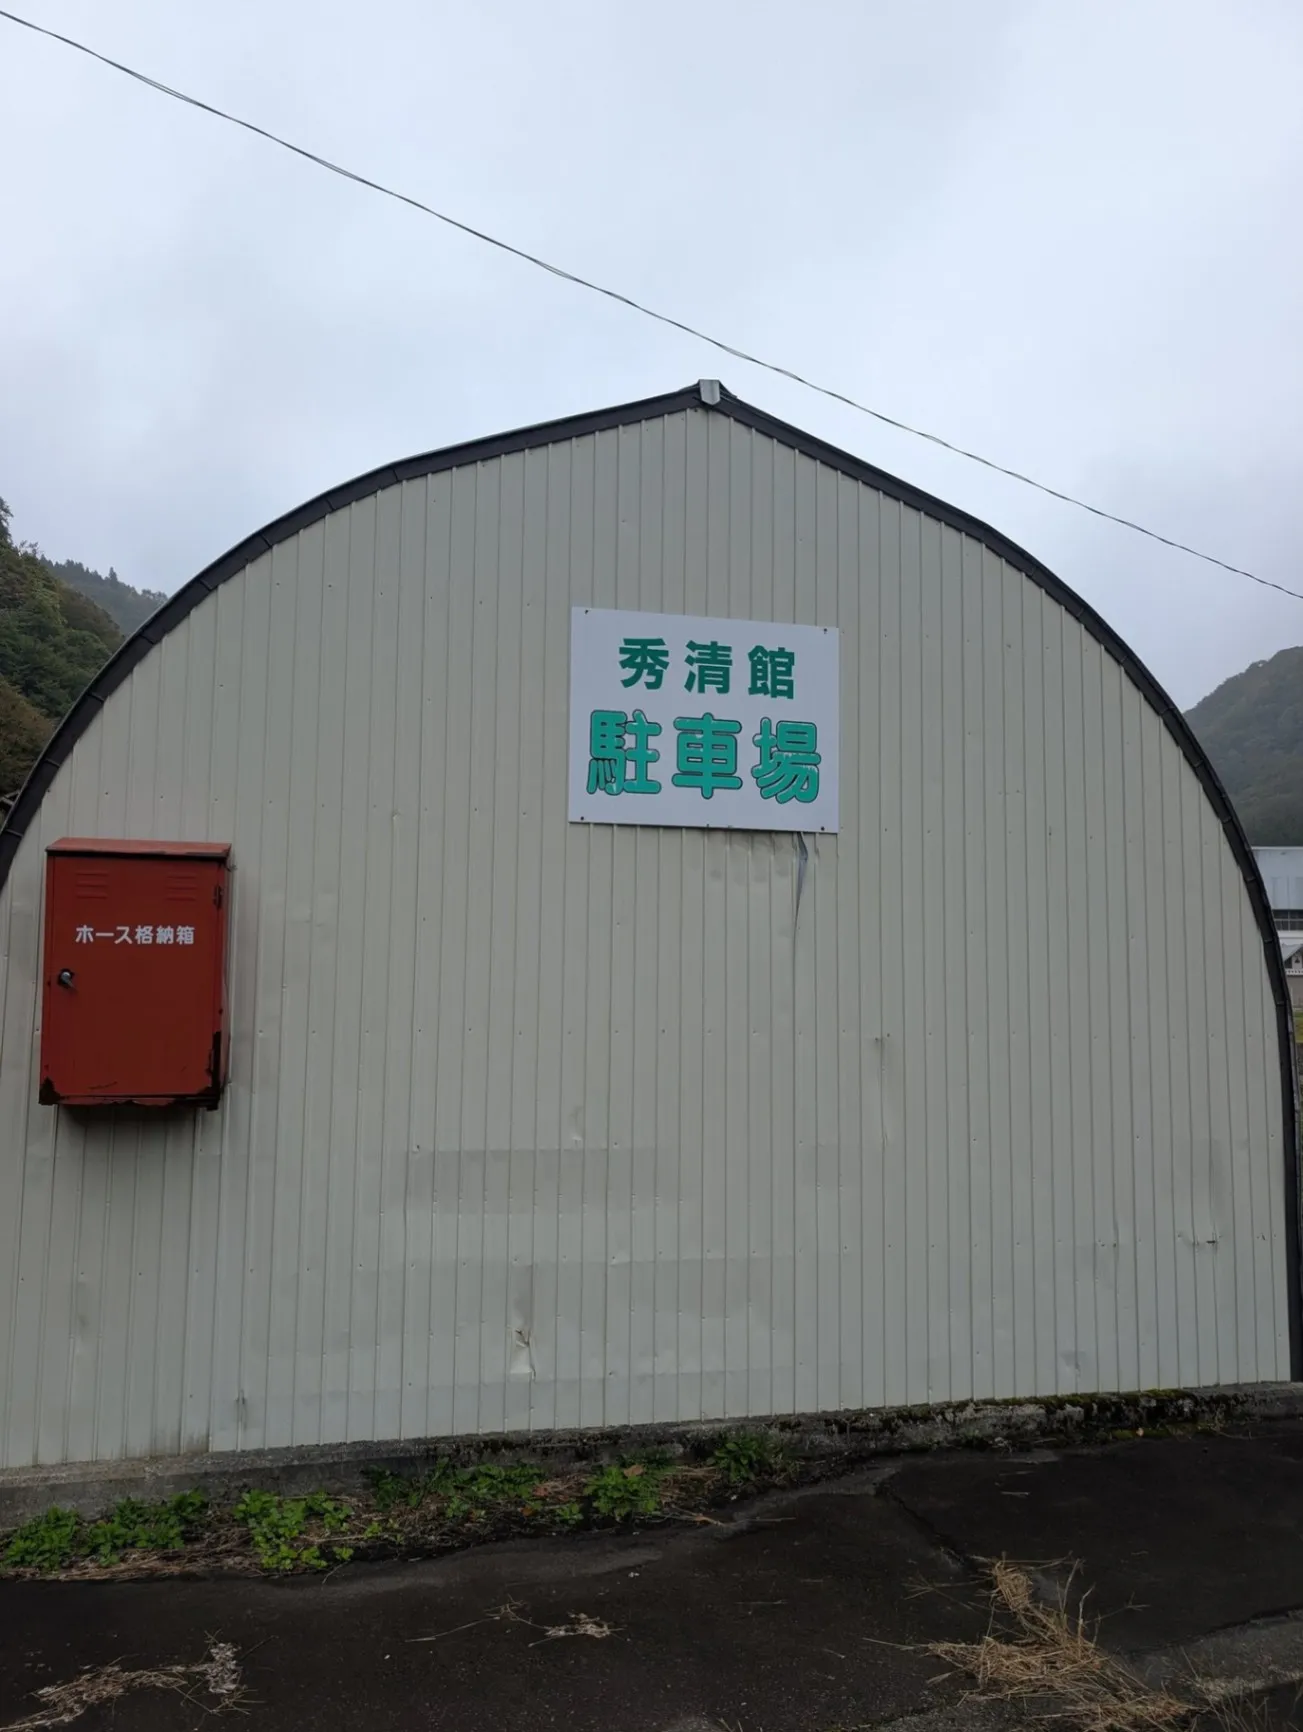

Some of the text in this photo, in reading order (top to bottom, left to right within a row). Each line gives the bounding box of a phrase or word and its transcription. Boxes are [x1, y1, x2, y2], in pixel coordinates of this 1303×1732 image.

[618, 637, 796, 700] 秀清館
[586, 709, 822, 804] 駐車場
[75, 925, 195, 945] ホース格納箱
